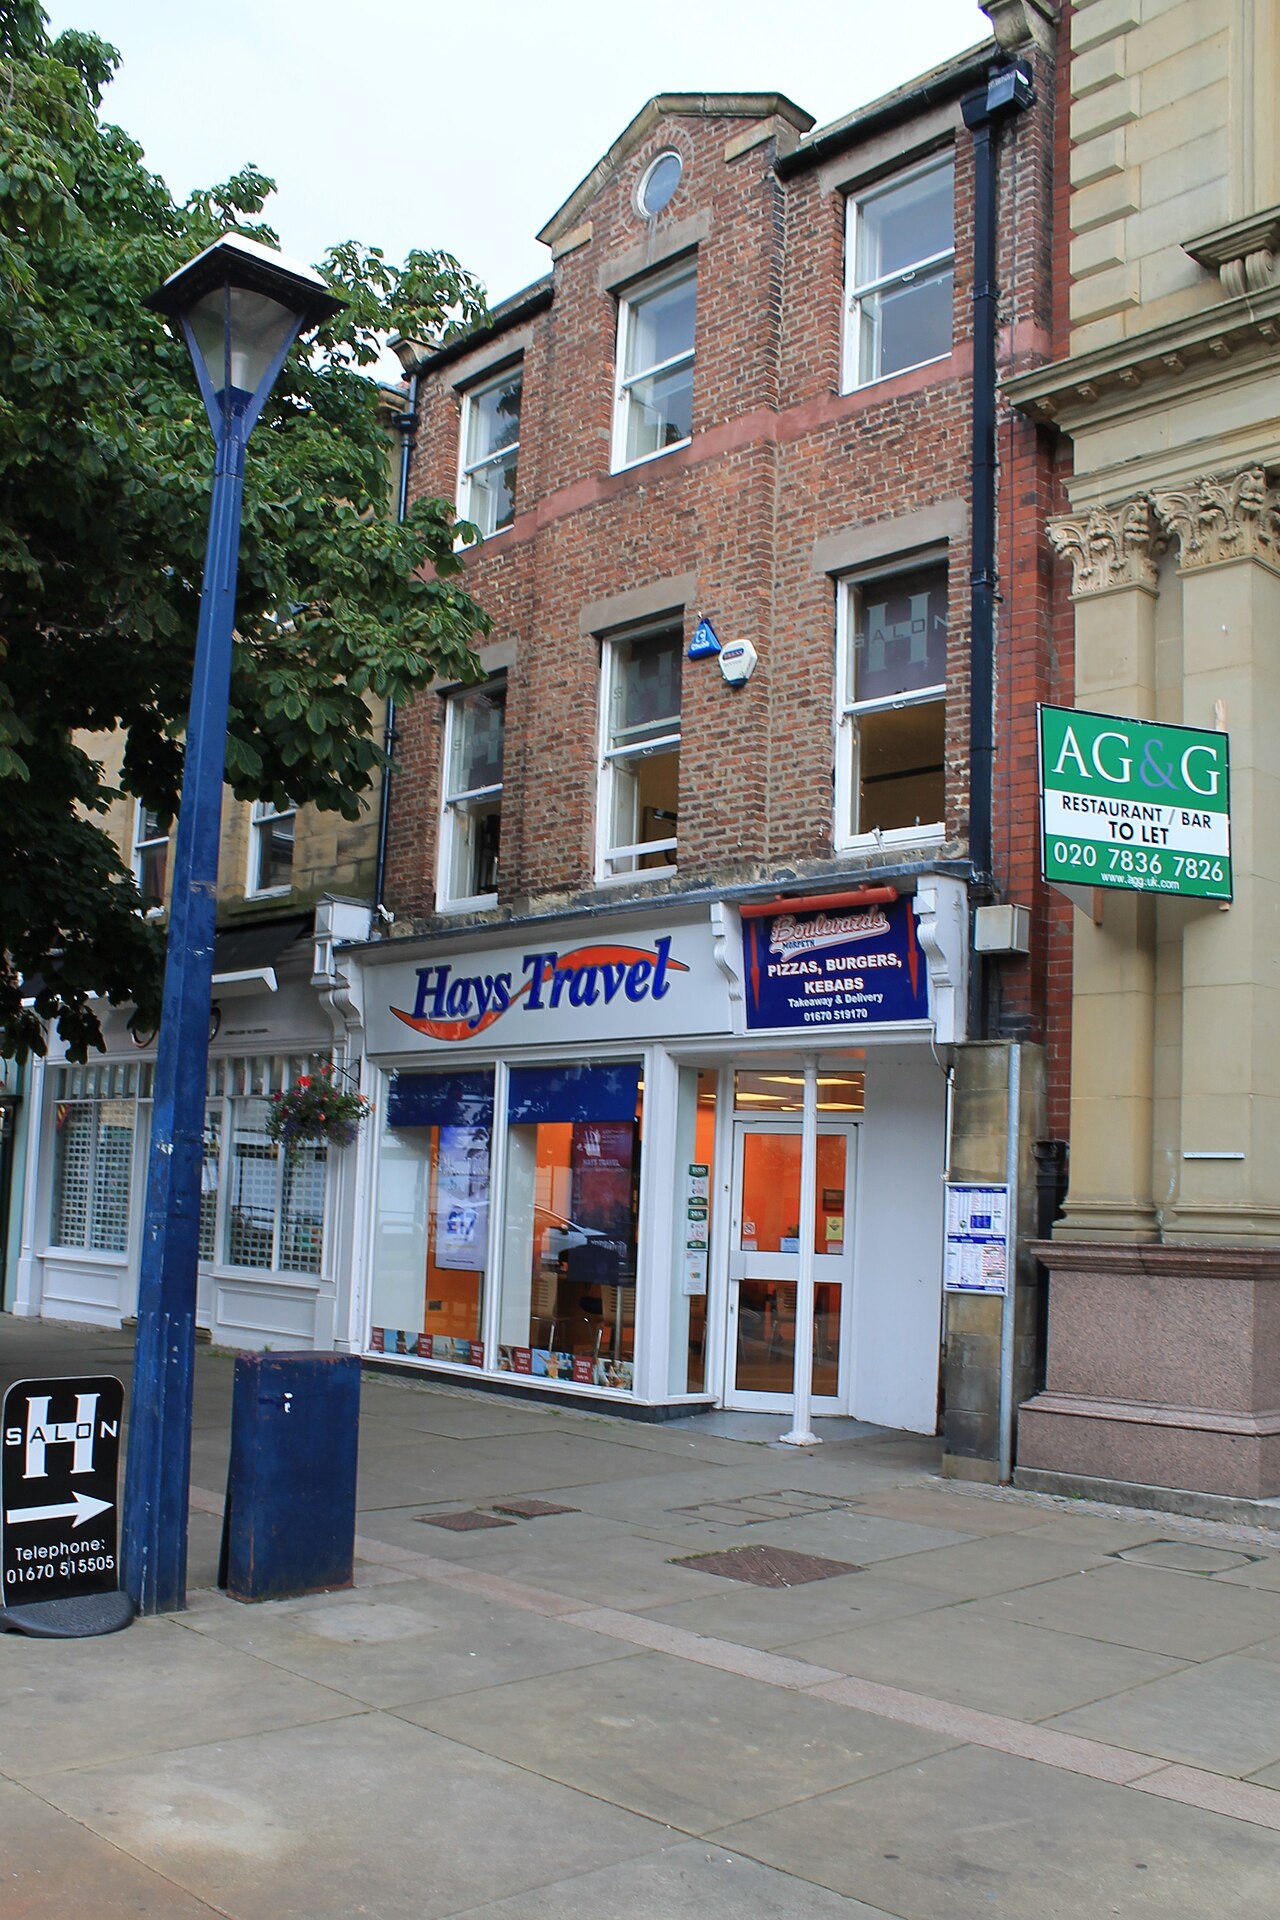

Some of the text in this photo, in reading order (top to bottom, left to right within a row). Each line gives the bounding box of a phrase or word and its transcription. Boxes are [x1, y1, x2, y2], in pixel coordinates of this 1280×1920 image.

[853, 613, 949, 648] SALON
[1051, 725, 1221, 796] AG&G
[1062, 795, 1163, 823] RESTAURANT
[1181, 811, 1212, 829] BAR
[1108, 820, 1170, 845] TO LET
[1053, 841, 1224, 882] 020 7836 7826
[1100, 871, 1180, 890] www.agg.uk.com
[767, 953, 902, 978] PIZZAS, BURGERS,
[411, 935, 672, 1029] Hays Travel
[804, 977, 864, 995] KEBABS
[788, 992, 884, 1008] Takeaway & Delivery
[803, 1011, 831, 1022] 01670
[5, 1420, 119, 1446] SALON
[22, 1393, 101, 1479] H
[15, 1538, 106, 1562] Telephone:
[6, 1555, 115, 1585] 01670 515505
